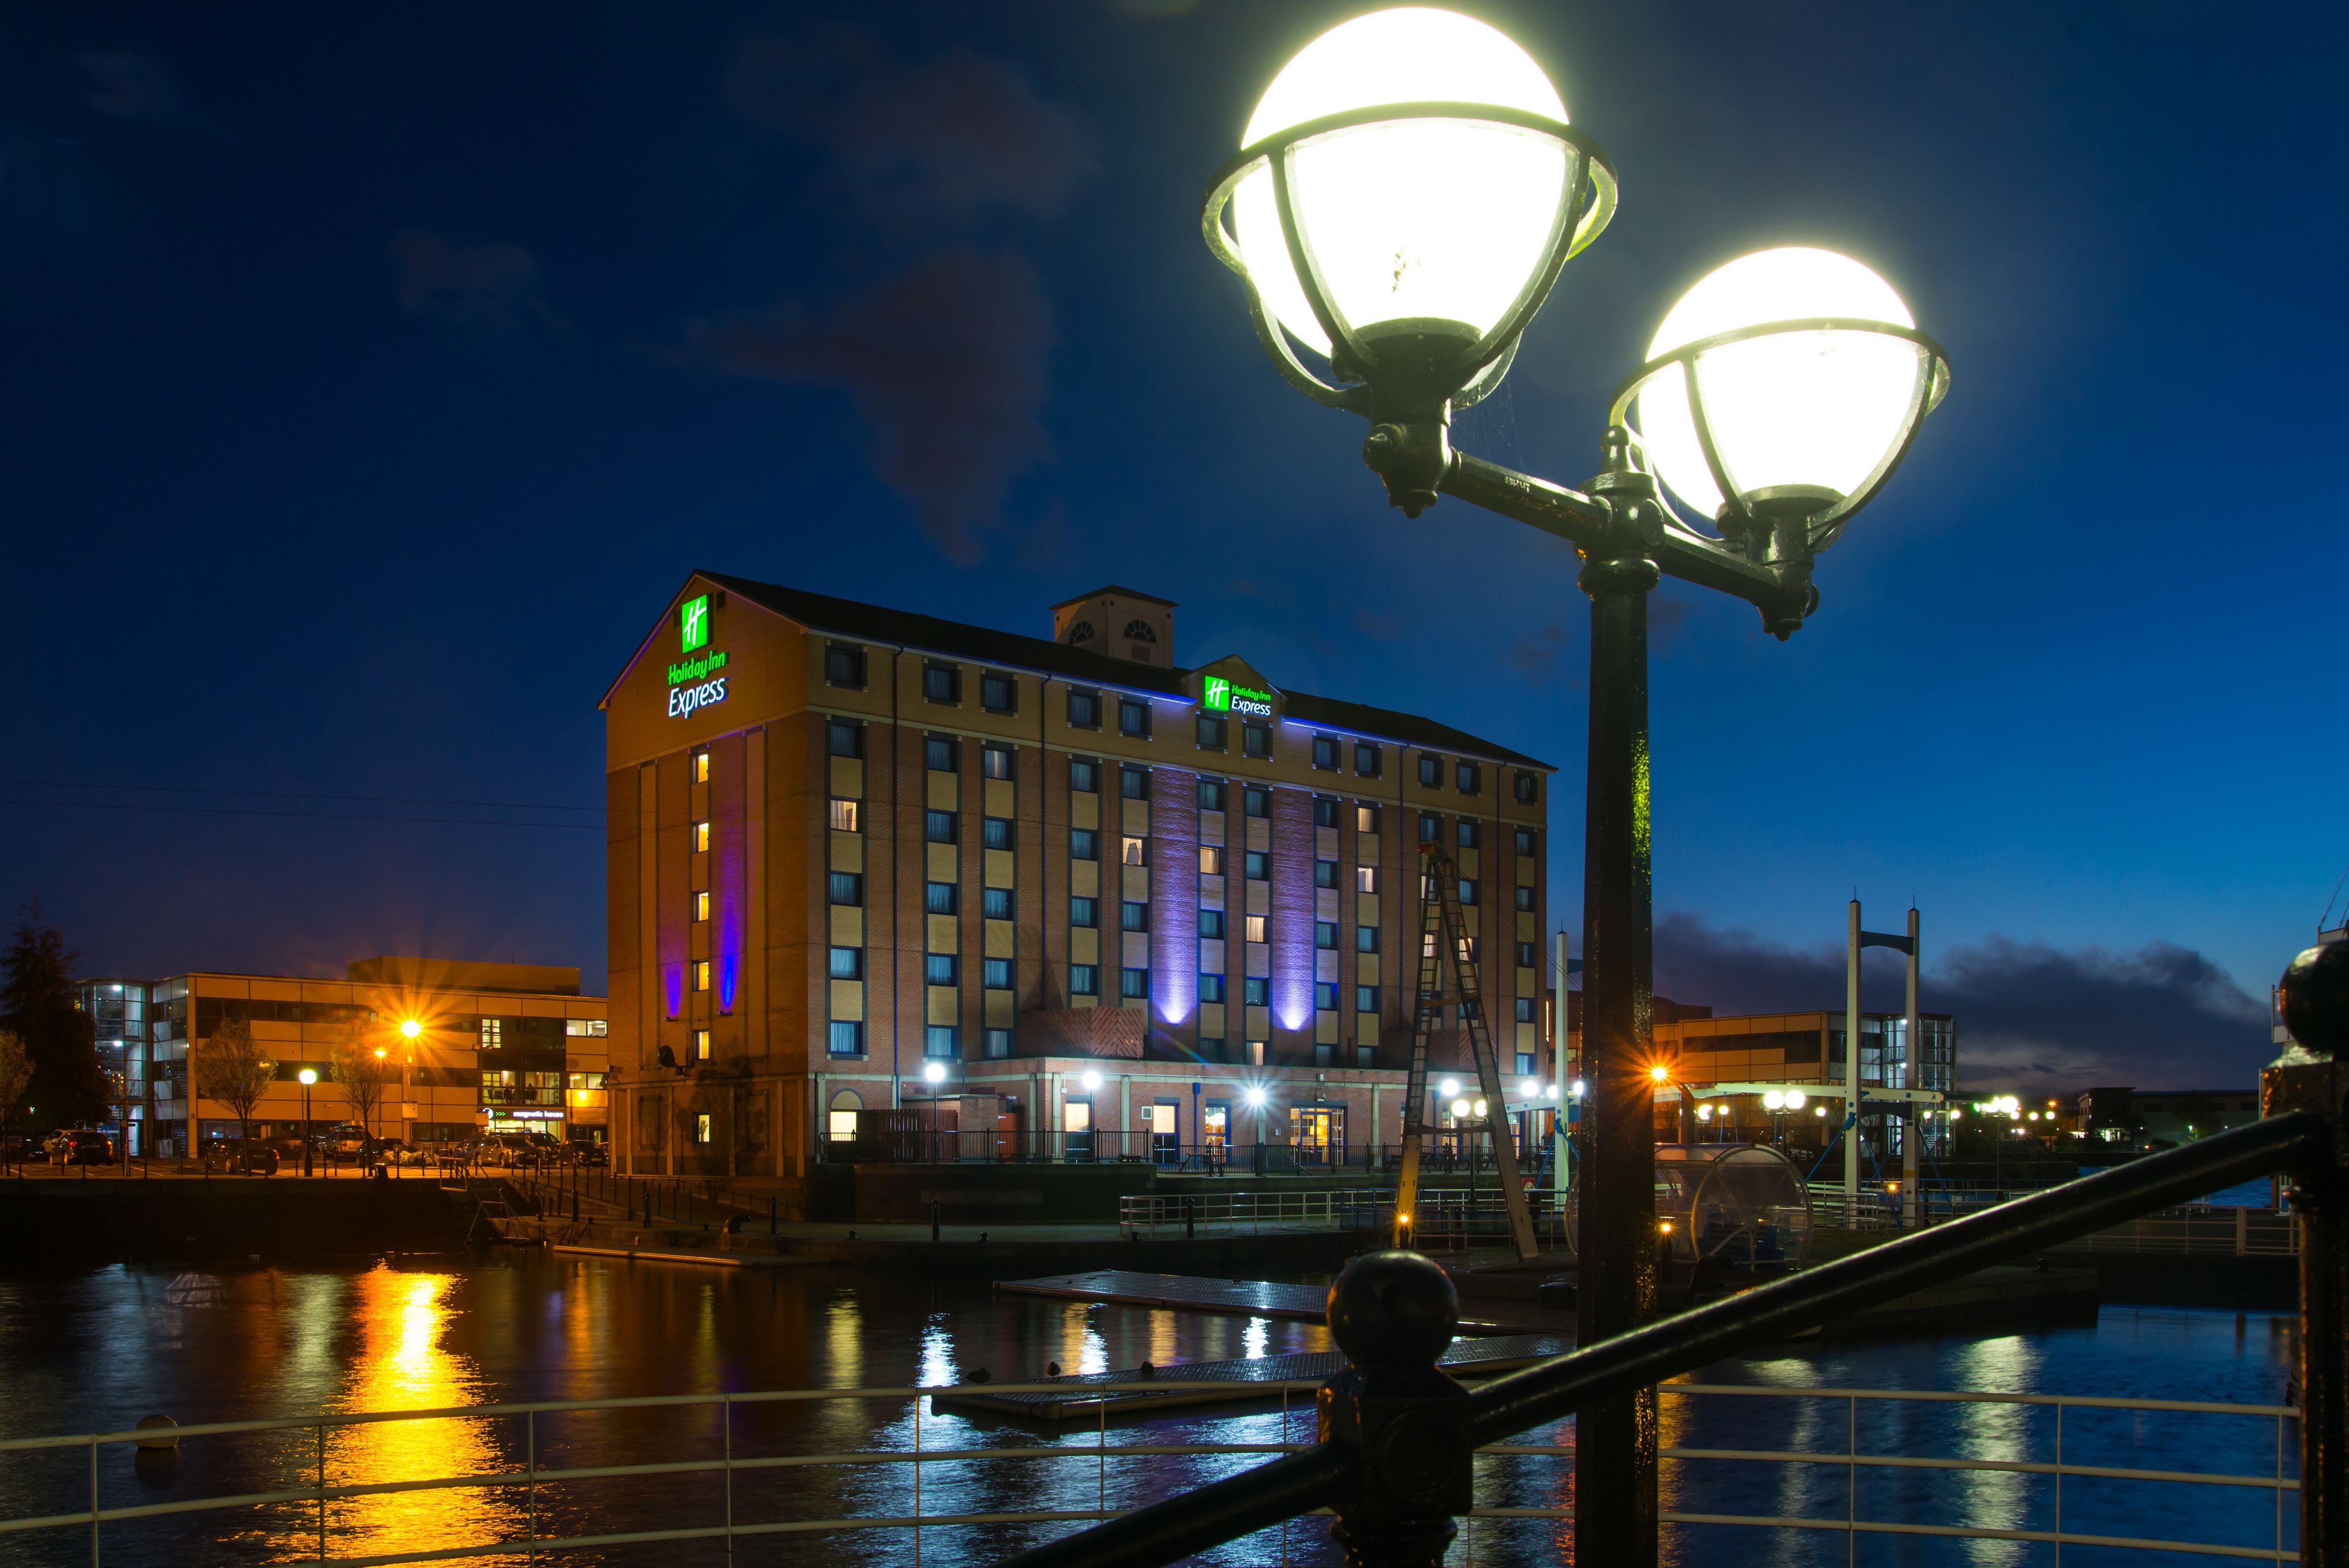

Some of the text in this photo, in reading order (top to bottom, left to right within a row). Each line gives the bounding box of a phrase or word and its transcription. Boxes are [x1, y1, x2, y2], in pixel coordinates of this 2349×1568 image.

[668, 650, 725, 685] Holiday Inn
[669, 677, 725, 719] Express
[1231, 685, 1271, 702] Holiday Inn
[1231, 696, 1271, 715] Express
